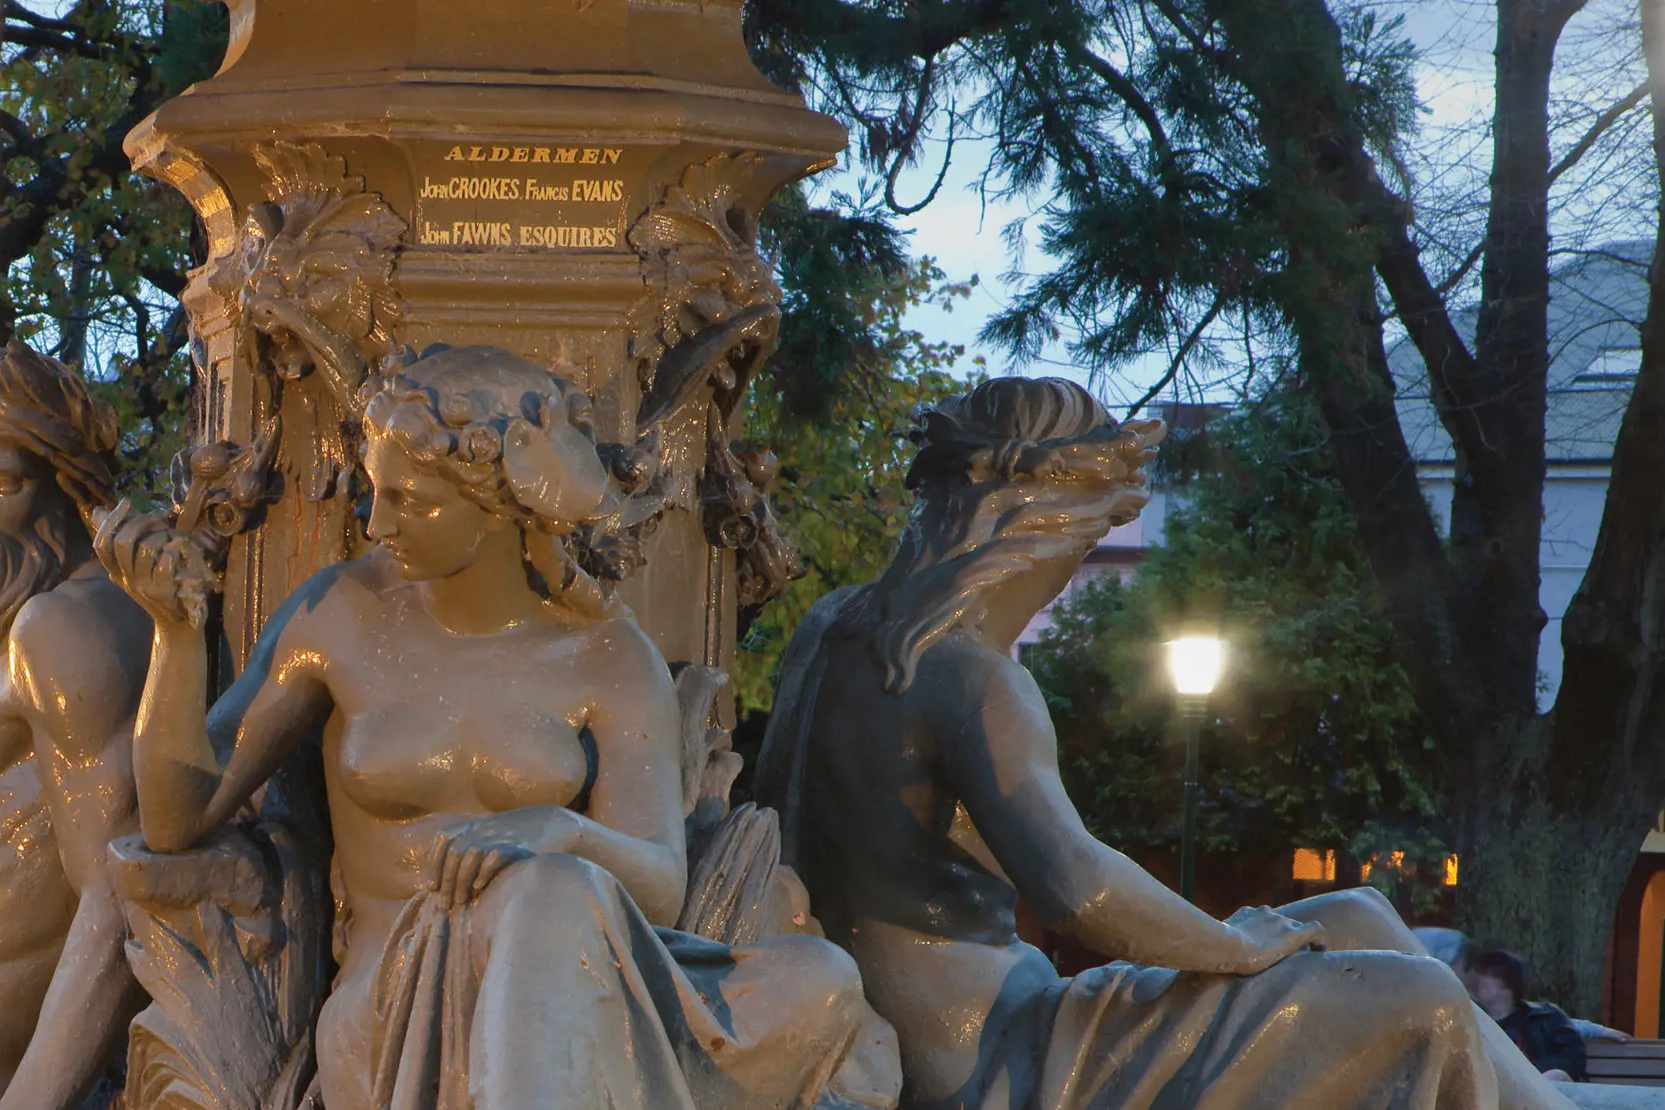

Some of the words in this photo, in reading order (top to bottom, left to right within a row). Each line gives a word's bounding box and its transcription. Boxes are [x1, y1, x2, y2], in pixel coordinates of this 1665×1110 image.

[444, 145, 623, 165] ALDERMEN
[571, 179, 624, 202] EVANS
[452, 222, 512, 246] FAWNS
[519, 225, 617, 249] ESQUIRES
